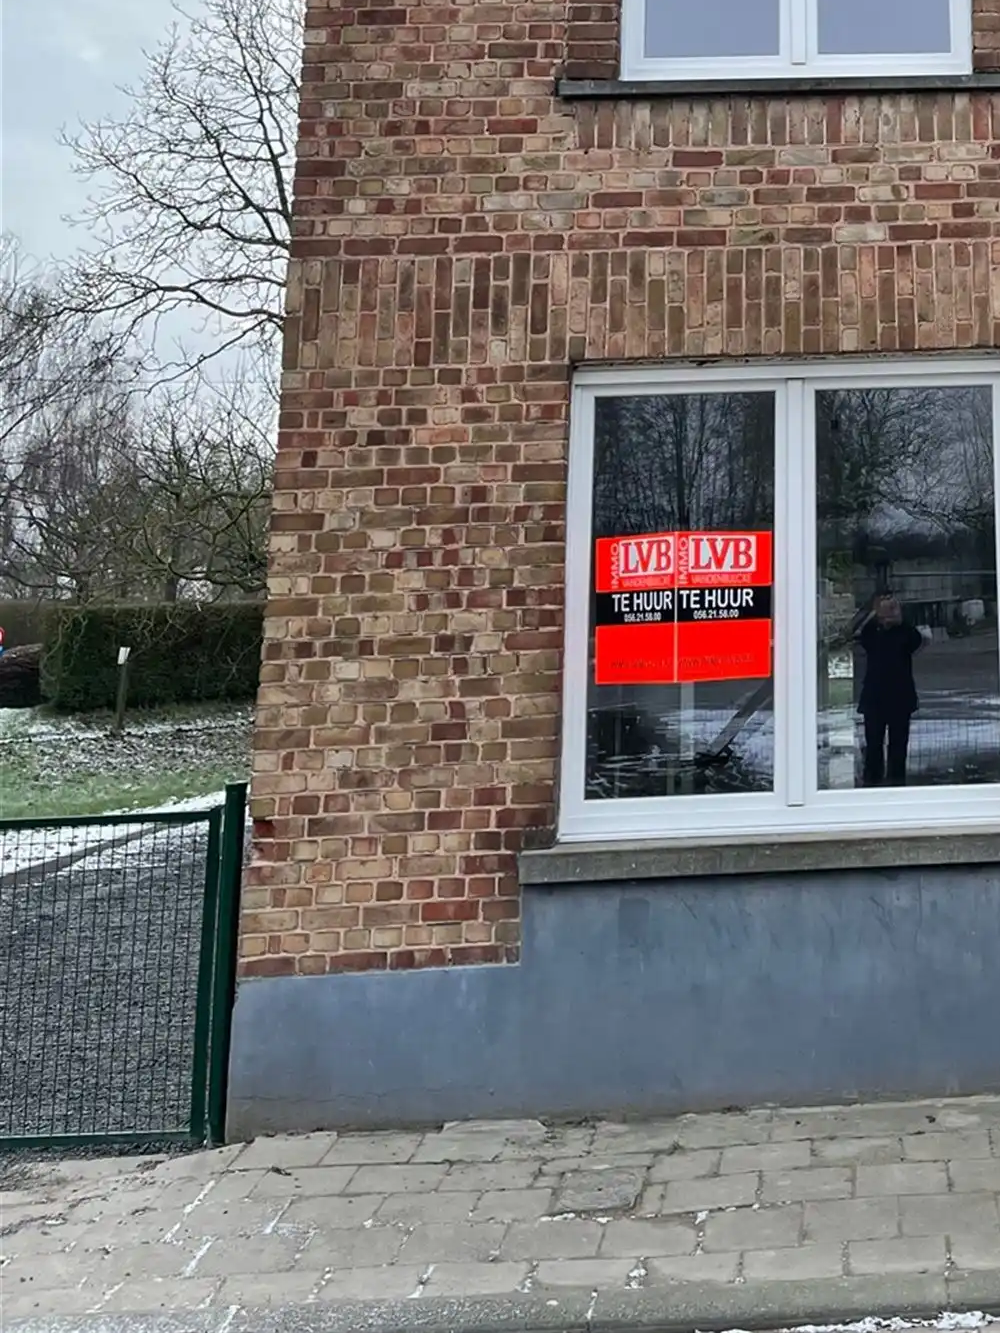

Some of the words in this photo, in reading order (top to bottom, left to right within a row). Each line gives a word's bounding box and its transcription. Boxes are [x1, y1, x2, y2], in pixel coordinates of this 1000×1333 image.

[611, 543, 619, 589] IMMO
[621, 539, 672, 574] LVB
[678, 538, 688, 584] IMMO
[691, 538, 754, 570] LVB
[612, 593, 630, 612] TE
[633, 591, 673, 611] HUUR
[679, 589, 701, 609] TE
[705, 587, 755, 608] HUUR
